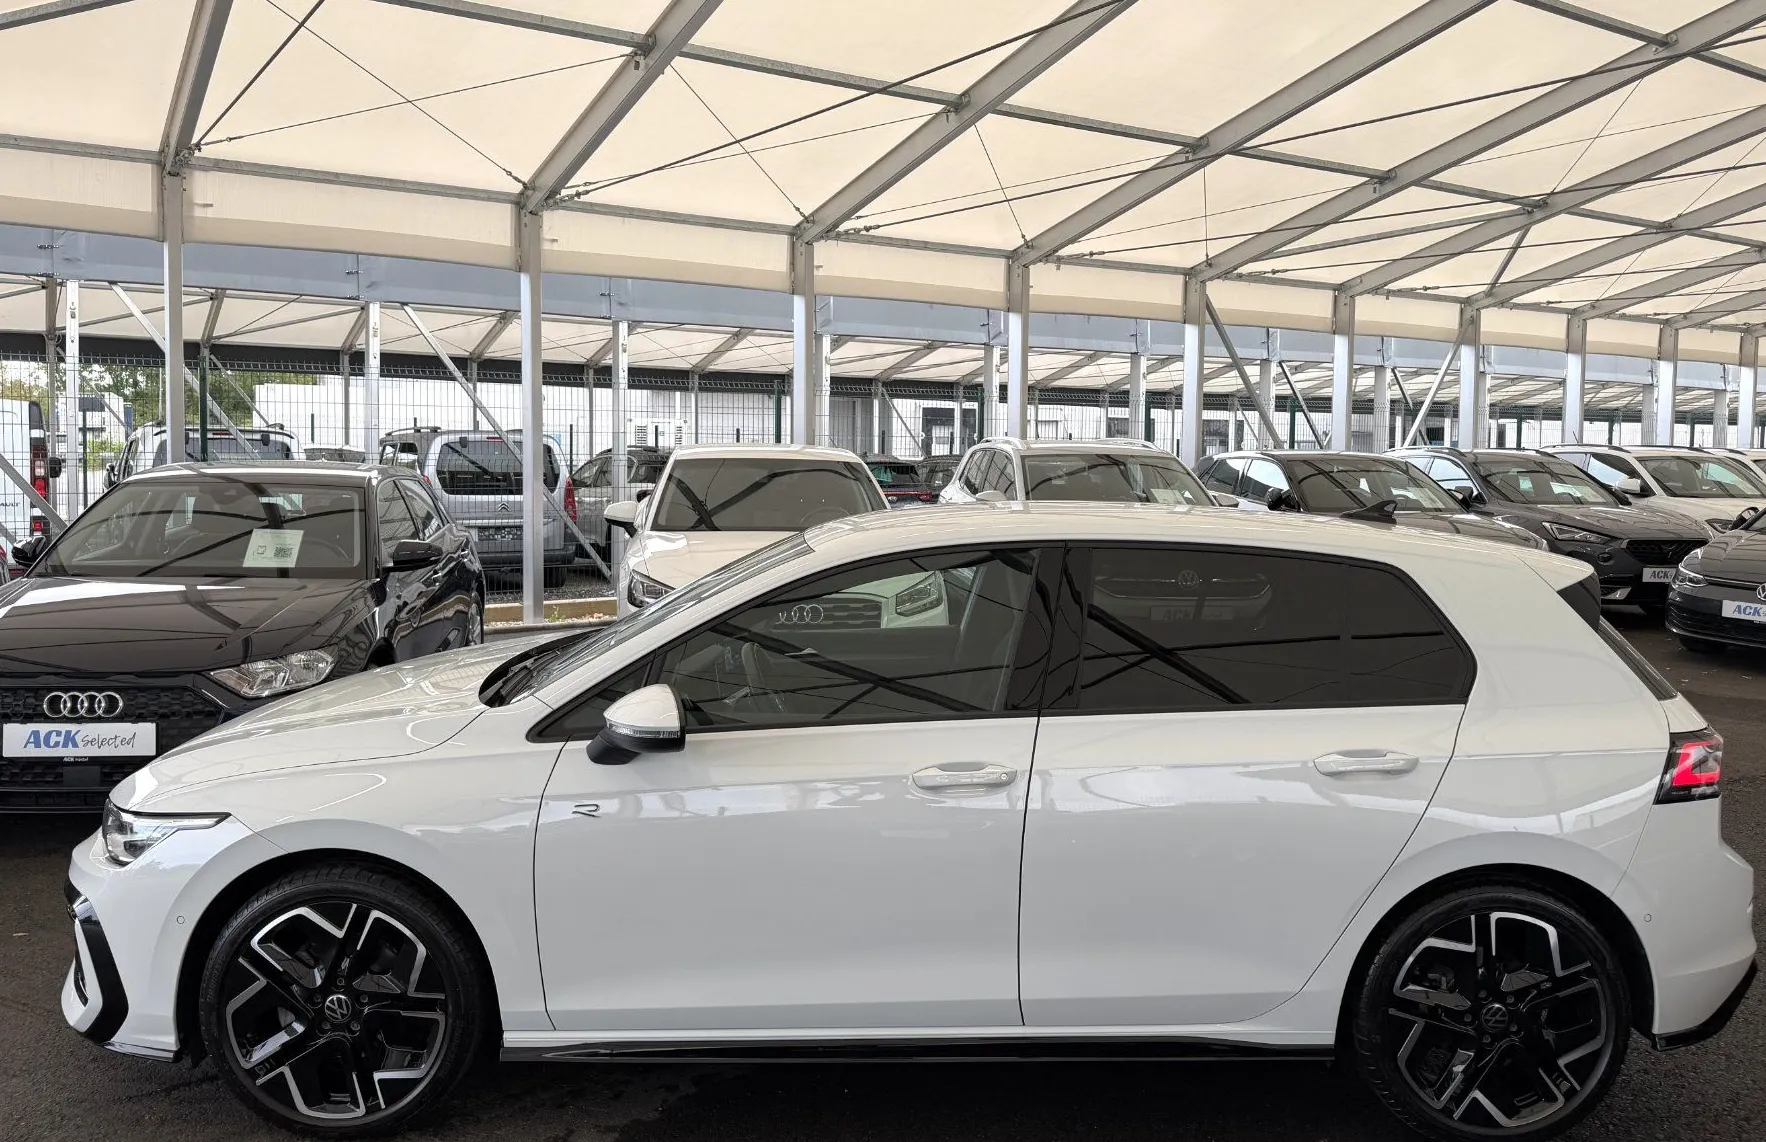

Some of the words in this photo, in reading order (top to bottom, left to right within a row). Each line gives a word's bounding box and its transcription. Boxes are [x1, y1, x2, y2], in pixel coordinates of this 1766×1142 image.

[1650, 570, 1670, 580] ACK
[1733, 604, 1762, 617] ACK
[23, 729, 81, 749] ACK
[81, 731, 137, 749] Selected
